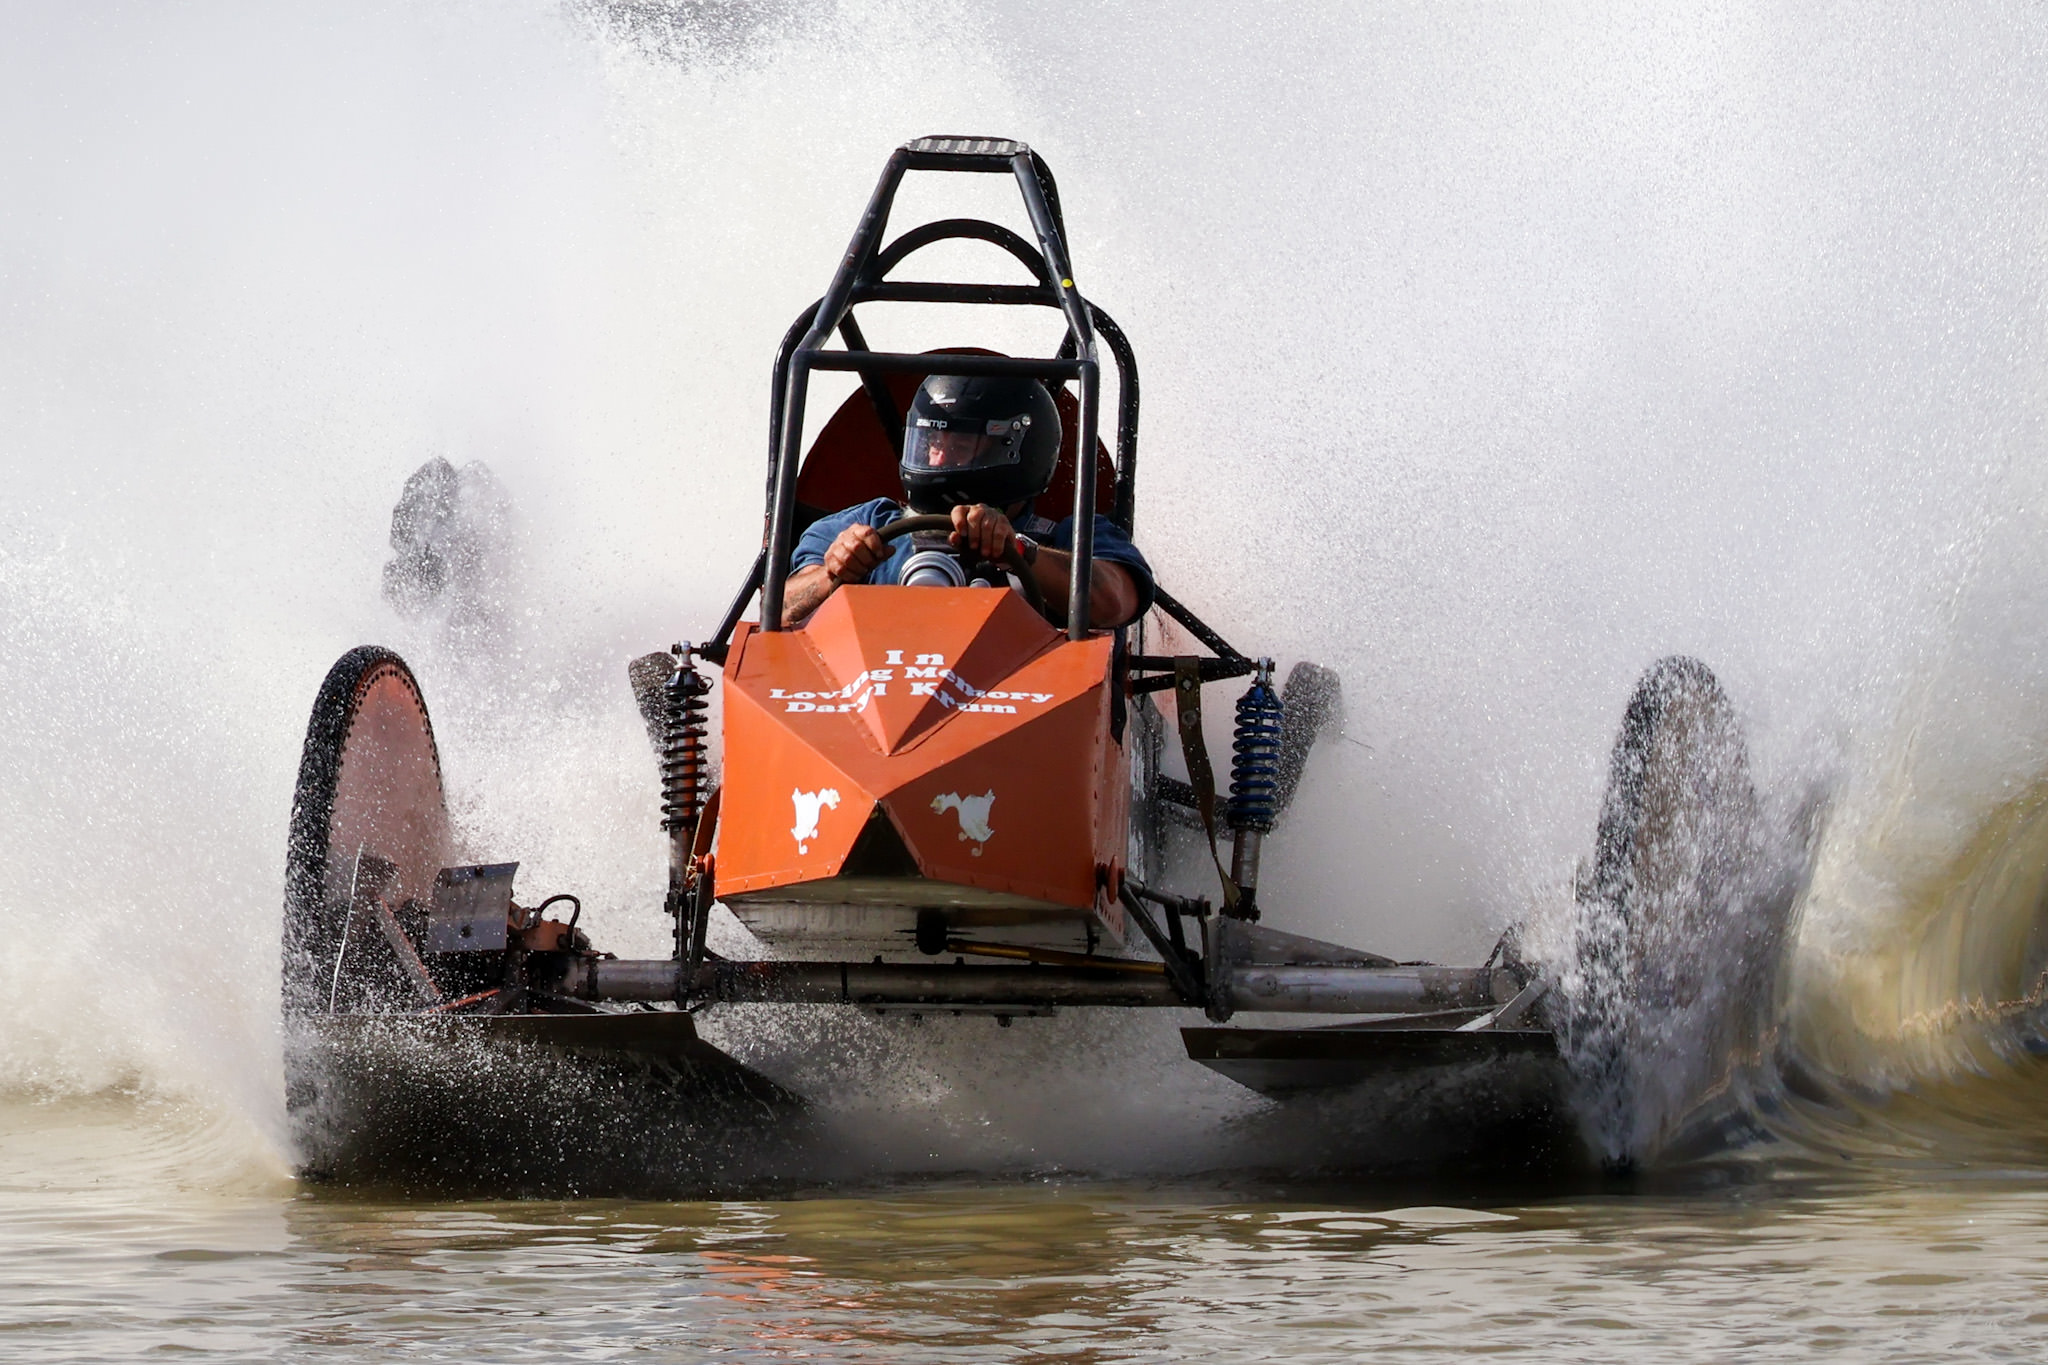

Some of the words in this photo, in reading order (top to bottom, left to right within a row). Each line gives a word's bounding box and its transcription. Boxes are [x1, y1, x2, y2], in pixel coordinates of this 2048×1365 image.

[885, 649, 945, 666] In
[769, 668, 894, 699] Loving
[904, 666, 1054, 703] Memory
[784, 682, 887, 713] Daryl
